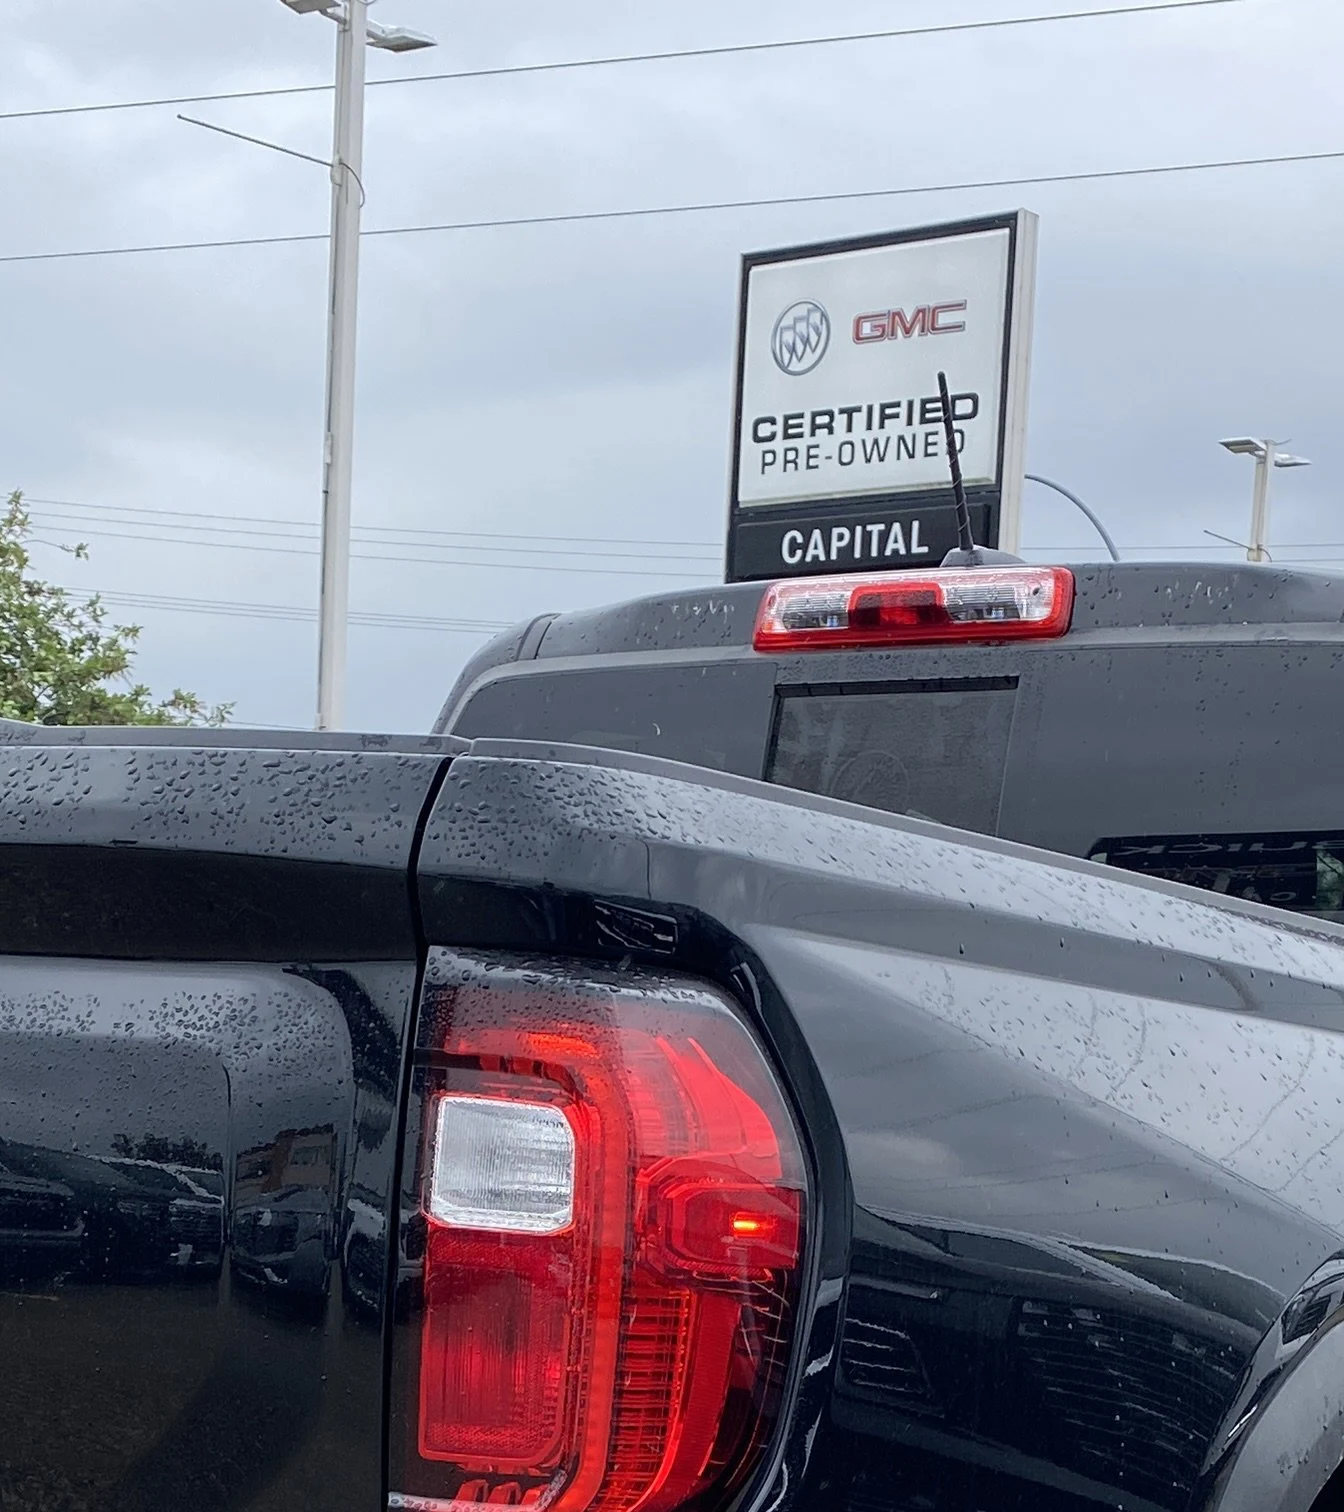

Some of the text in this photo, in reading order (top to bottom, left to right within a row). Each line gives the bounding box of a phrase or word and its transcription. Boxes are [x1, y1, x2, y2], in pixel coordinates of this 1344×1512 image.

[852, 299, 967, 345] GMC
[752, 392, 979, 443] CERTIFIED
[761, 428, 965, 475] PRE-OWNED
[781, 520, 929, 565] CAPITAL
